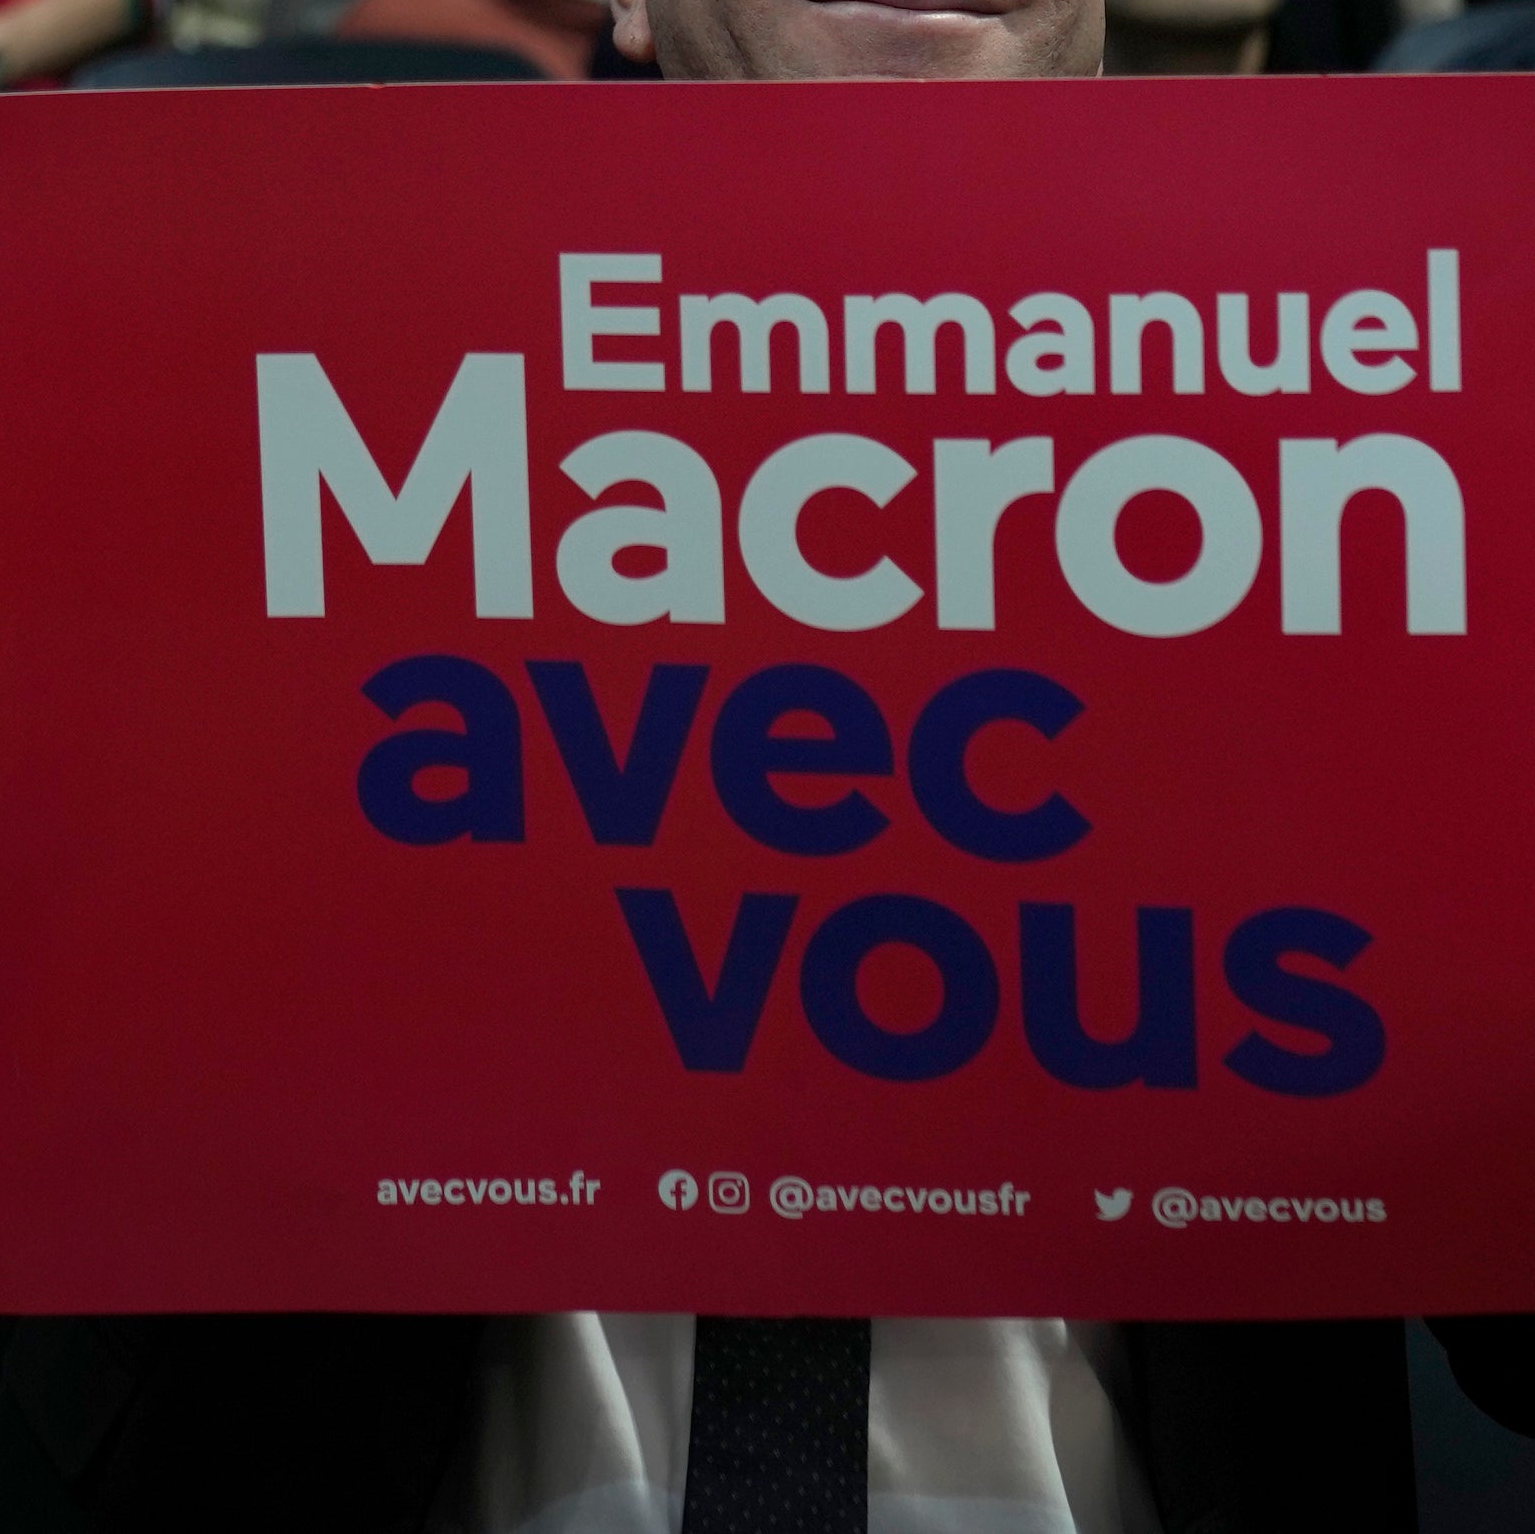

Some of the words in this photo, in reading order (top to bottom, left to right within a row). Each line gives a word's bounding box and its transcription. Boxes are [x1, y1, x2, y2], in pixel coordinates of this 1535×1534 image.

[559, 248, 1462, 397] Emmanuel
[255, 352, 1467, 638] Macron
[358, 656, 1089, 861] avec
[618, 888, 1385, 1096] vous
[377, 1170, 601, 1205] avecvous.fr
[769, 1177, 1032, 1219] @avecvousfr
[1153, 1189, 1387, 1227] @avecvous
